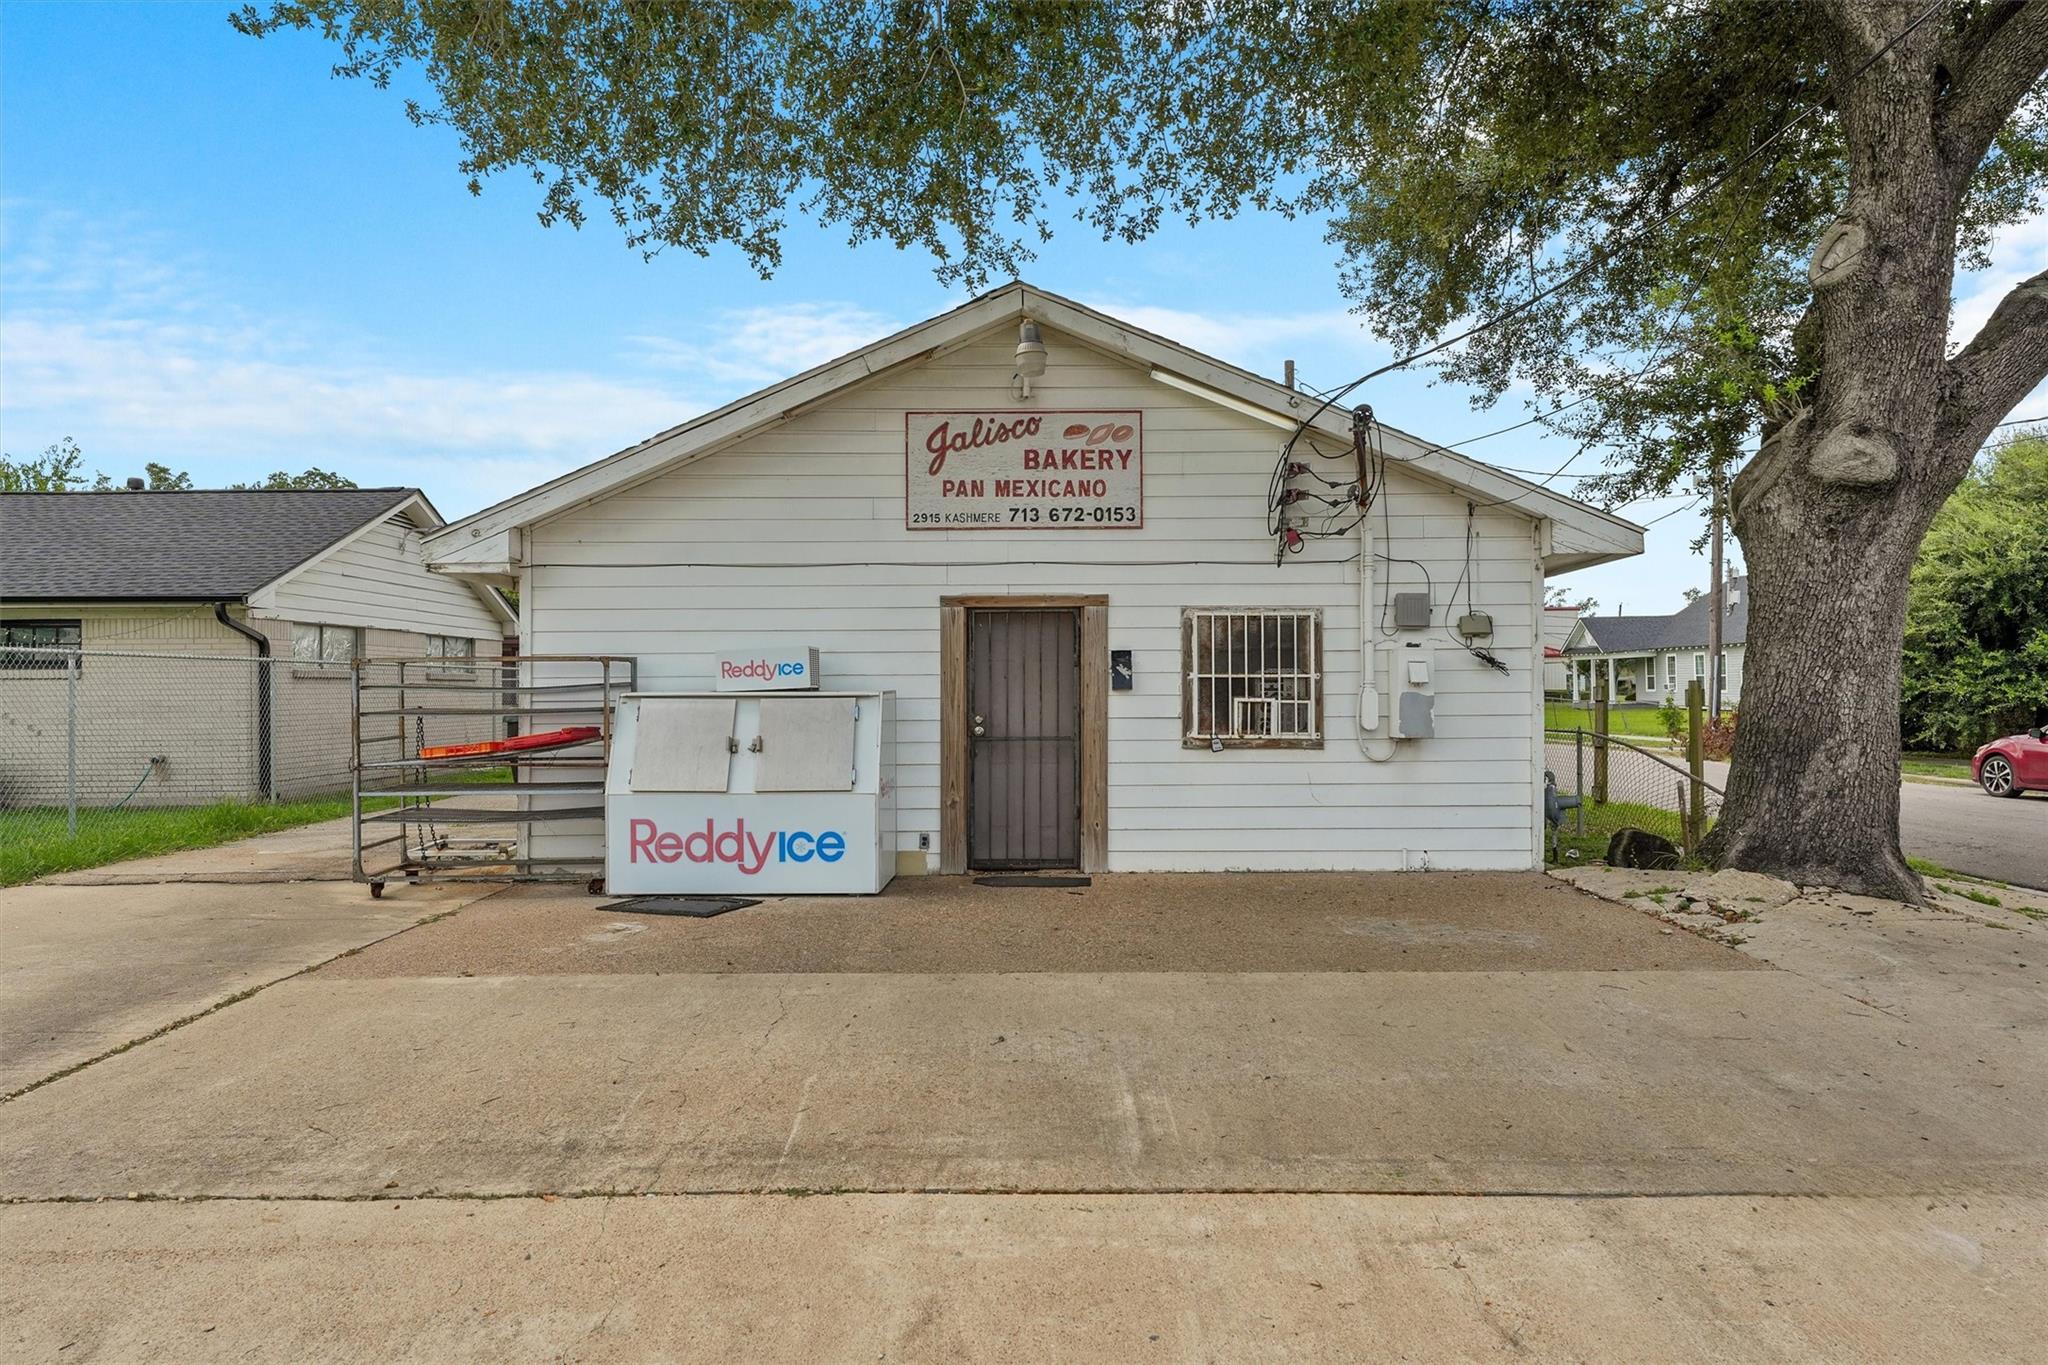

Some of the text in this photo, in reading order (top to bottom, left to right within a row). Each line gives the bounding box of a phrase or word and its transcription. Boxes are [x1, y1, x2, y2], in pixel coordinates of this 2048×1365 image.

[1024, 449, 1133, 470] BAKERY
[942, 479, 1107, 498] PAN MEXICANO
[913, 506, 1137, 523] 2915 KASHMERE 713 672-0153
